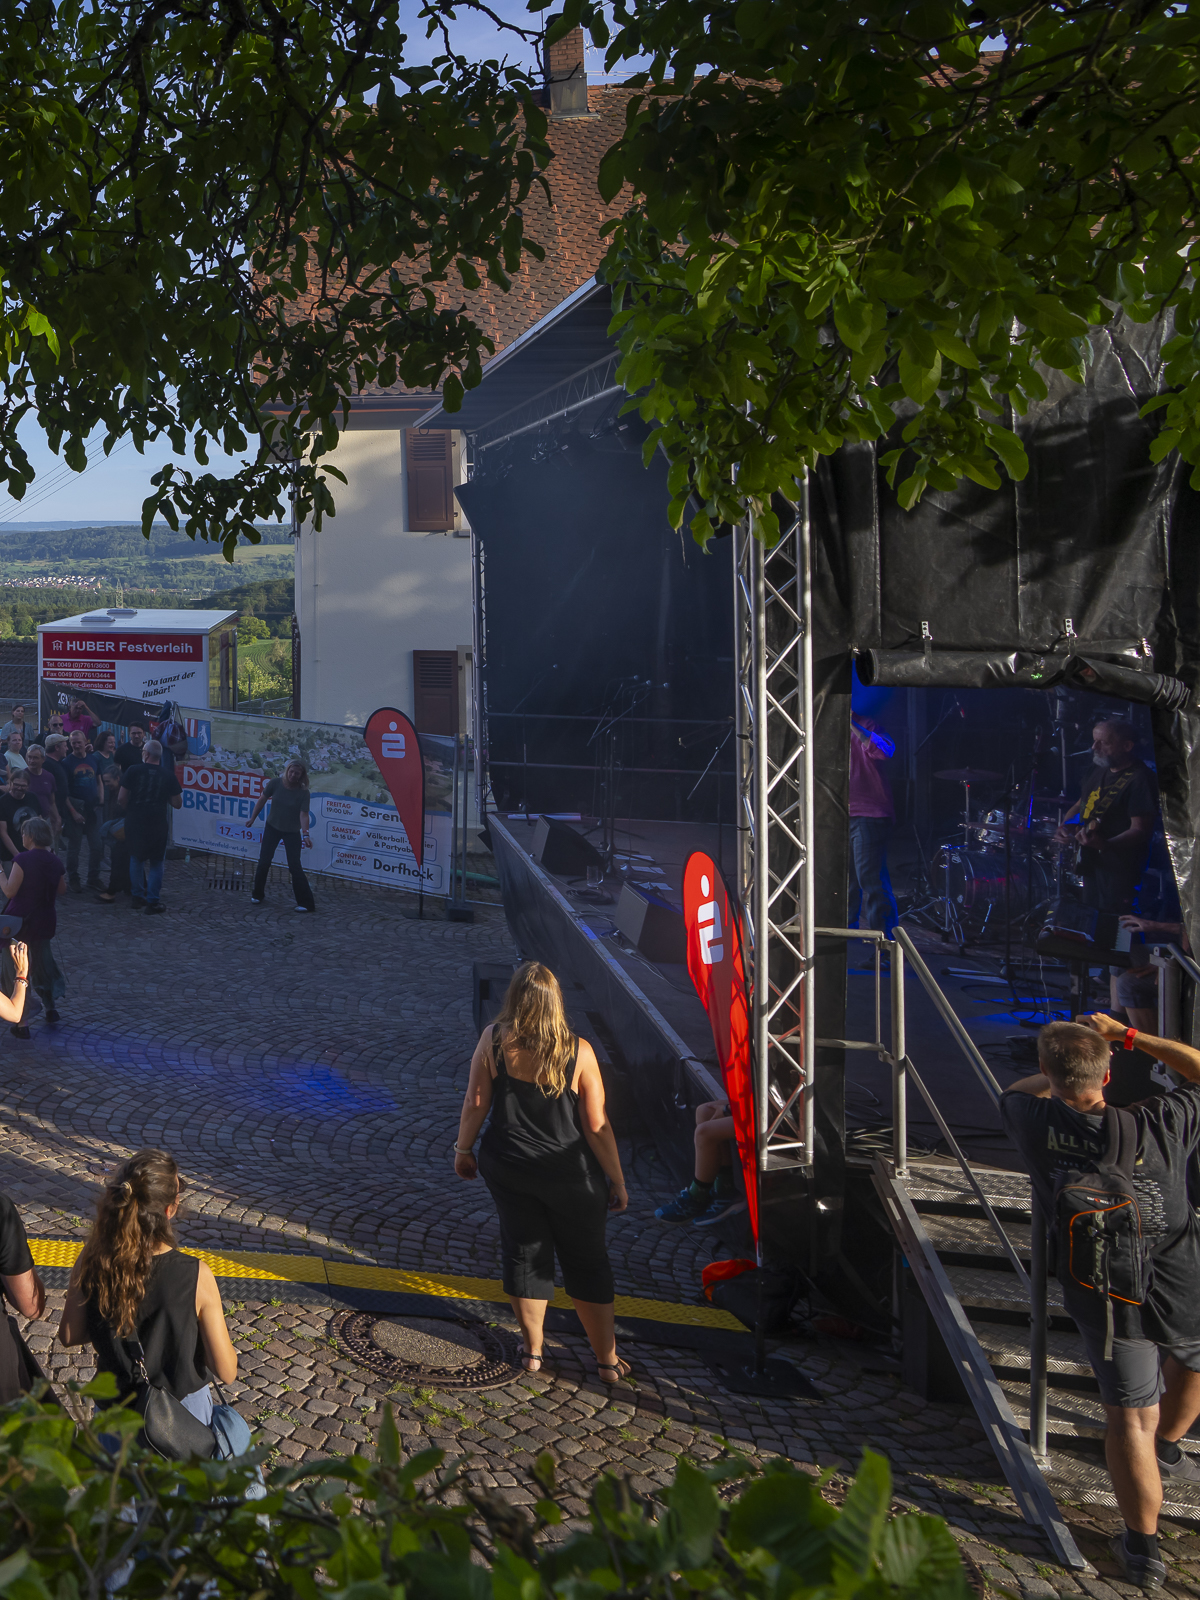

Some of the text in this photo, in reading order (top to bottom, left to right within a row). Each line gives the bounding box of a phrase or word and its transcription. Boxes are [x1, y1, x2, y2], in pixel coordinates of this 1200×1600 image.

[66, 640, 193, 654] HUBER Festverleih
[160, 674, 180, 685] tanzt
[181, 671, 196, 680] der
[326, 800, 351, 809] FREITAG
[332, 826, 360, 836] SAMSTAG
[181, 836, 248, 853] www.breitenfeld-wt.de
[366, 831, 434, 849] Völkerball-ier
[337, 851, 367, 861] SONNTAG
